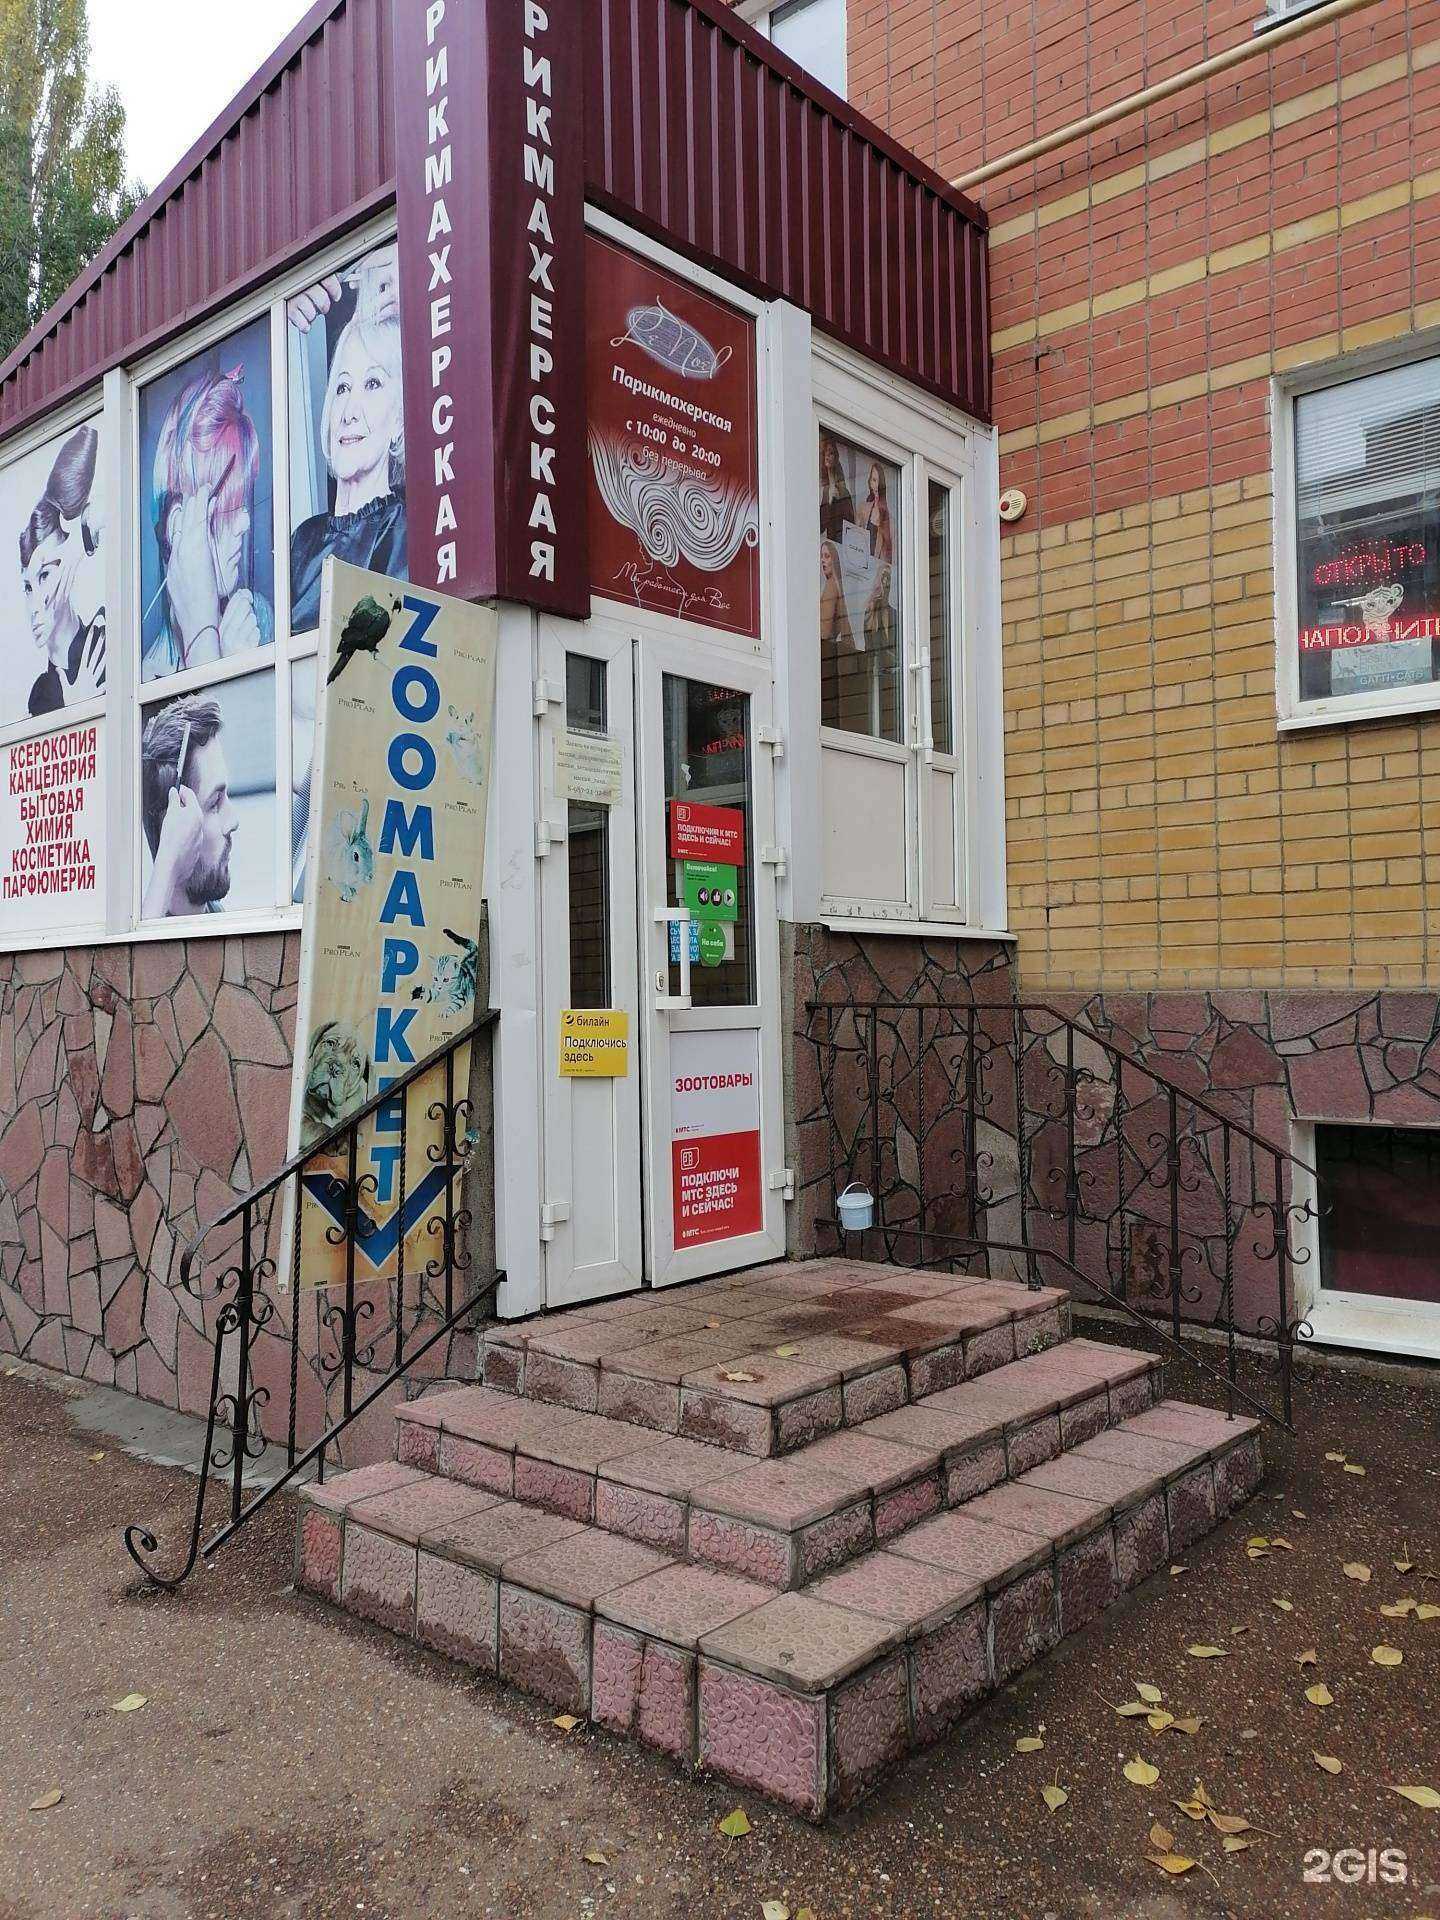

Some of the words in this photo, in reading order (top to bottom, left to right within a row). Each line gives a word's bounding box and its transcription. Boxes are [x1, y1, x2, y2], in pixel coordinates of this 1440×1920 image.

[612, 365, 732, 433] Парикмахерская
[652, 412, 697, 438] ежедневно
[626, 420, 633, 430] с
[636, 420, 667, 444] 10:00
[672, 435, 686, 453] до
[691, 444, 721, 467] 20:00
[642, 445, 659, 462] без
[661, 456, 707, 481] перерыва
[1315, 543, 1426, 585] ОТКРЫТО
[10, 727, 97, 770] КСЕРОКОПИЯ
[9, 754, 96, 795] КАНЦЕЛЯРИЯ
[20, 787, 84, 821] БЫТОВАЯ
[26, 813, 73, 845] ХИМИЯ
[677, 832, 699, 843] ЗДЕСЬ
[699, 835, 705, 843] И
[12, 838, 91, 872] КОСМЕТИКА
[3, 865, 96, 899] ПАРФЮМЕРИЯ
[576, 1015, 610, 1027] билайн
[564, 1036, 627, 1049] Подключись
[564, 1053, 594, 1063] здесь
[675, 1073, 753, 1092] ЗООТОВАРЫ
[681, 1167, 740, 1187] ПОДКЛЮЧИ
[681, 1188, 704, 1202] МТС
[705, 1183, 738, 1199] ЗДЕСЬ
[681, 1205, 690, 1218] И
[691, 1197, 734, 1215] СЕЙЧАС!
